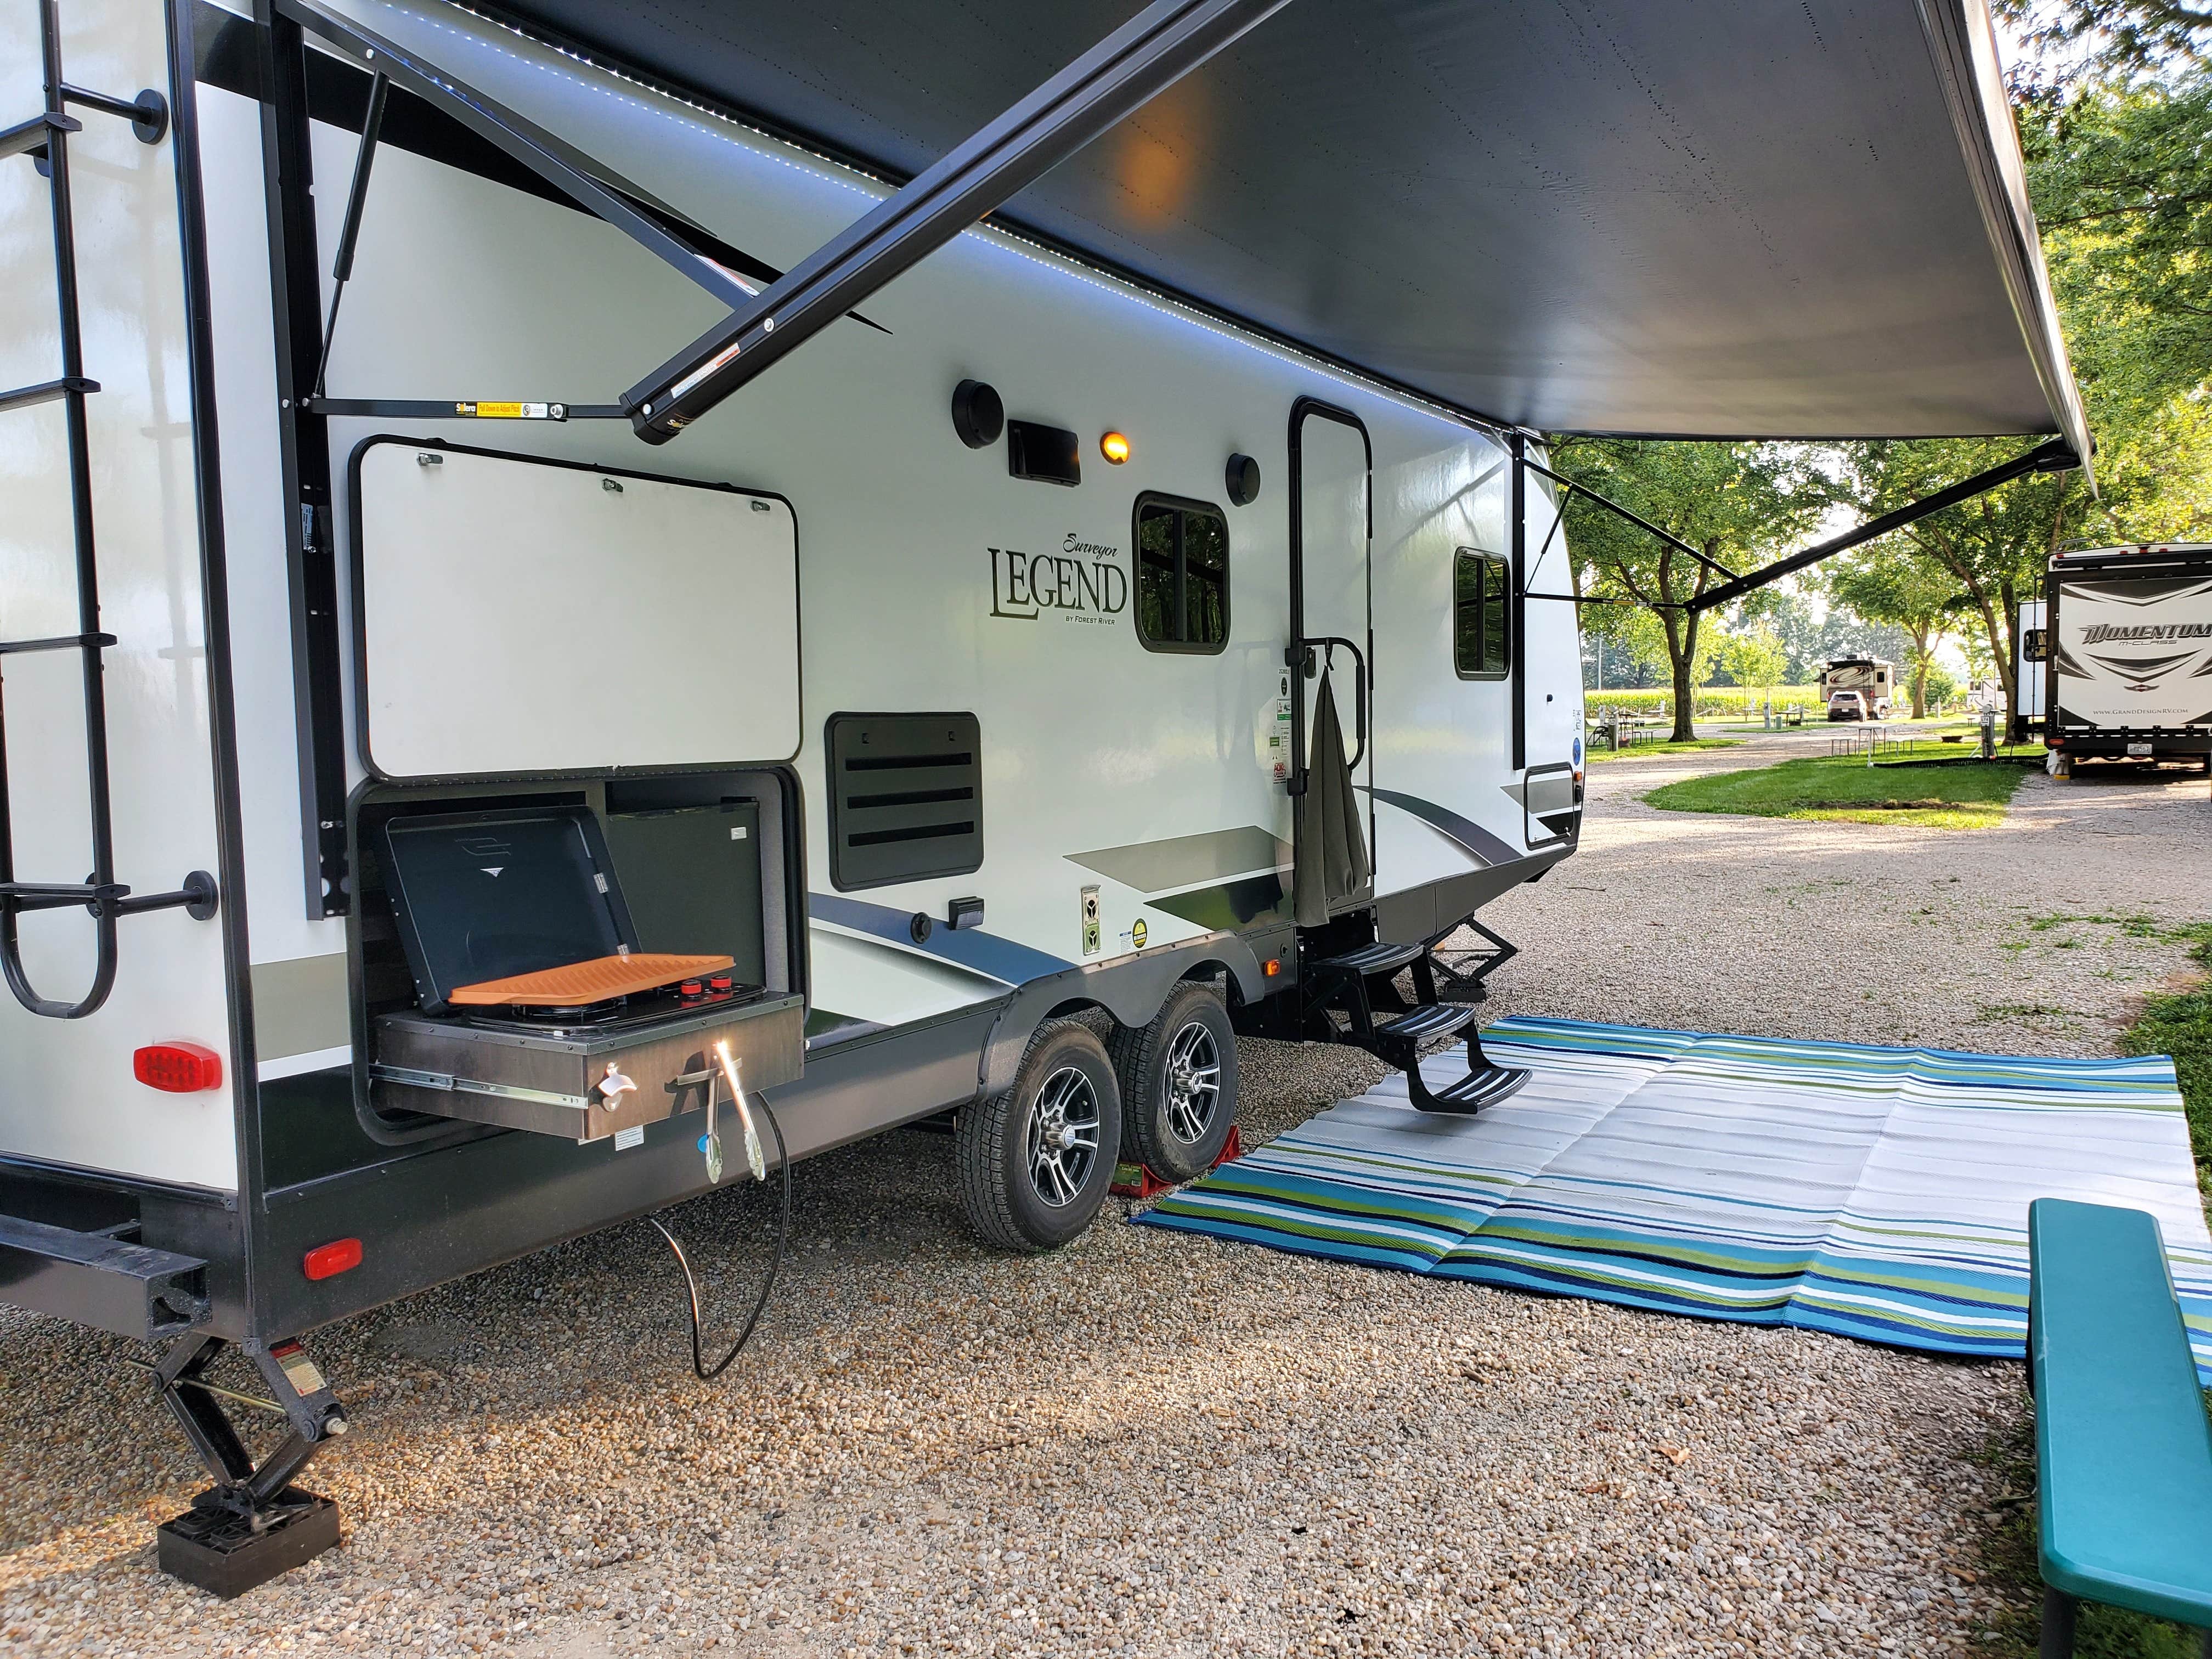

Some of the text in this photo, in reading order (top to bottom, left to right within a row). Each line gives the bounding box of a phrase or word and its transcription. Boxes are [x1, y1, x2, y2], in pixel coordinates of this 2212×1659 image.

[456, 402, 476, 412] Solera
[1063, 533, 1118, 560] Surveyor
[988, 548, 1127, 620] LEGEND
[1075, 616, 1097, 624] FOREST
[2077, 623, 2212, 645] MOMENTUM
